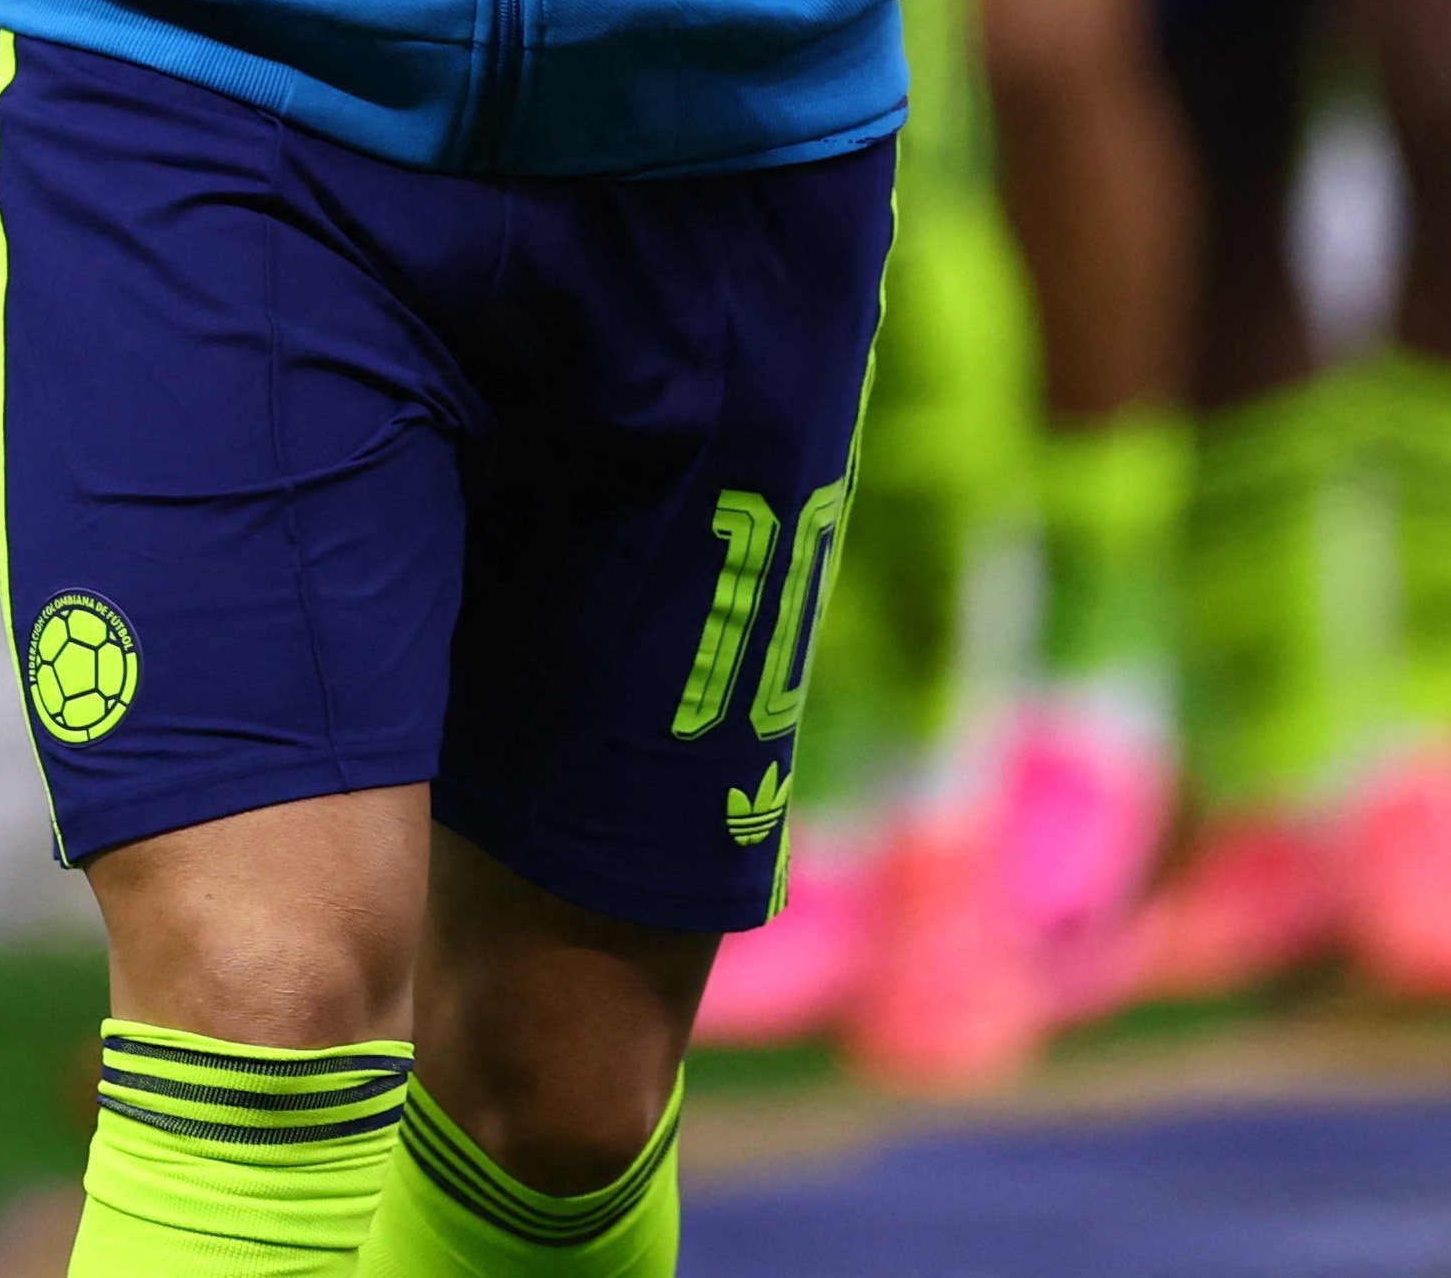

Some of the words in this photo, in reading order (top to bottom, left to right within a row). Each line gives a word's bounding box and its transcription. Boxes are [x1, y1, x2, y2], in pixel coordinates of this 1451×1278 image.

[42, 594, 95, 619] COLOMBIANA
[95, 601, 109, 617] DE
[105, 610, 135, 652] FÚTBOL
[671, 476, 845, 742] 10
